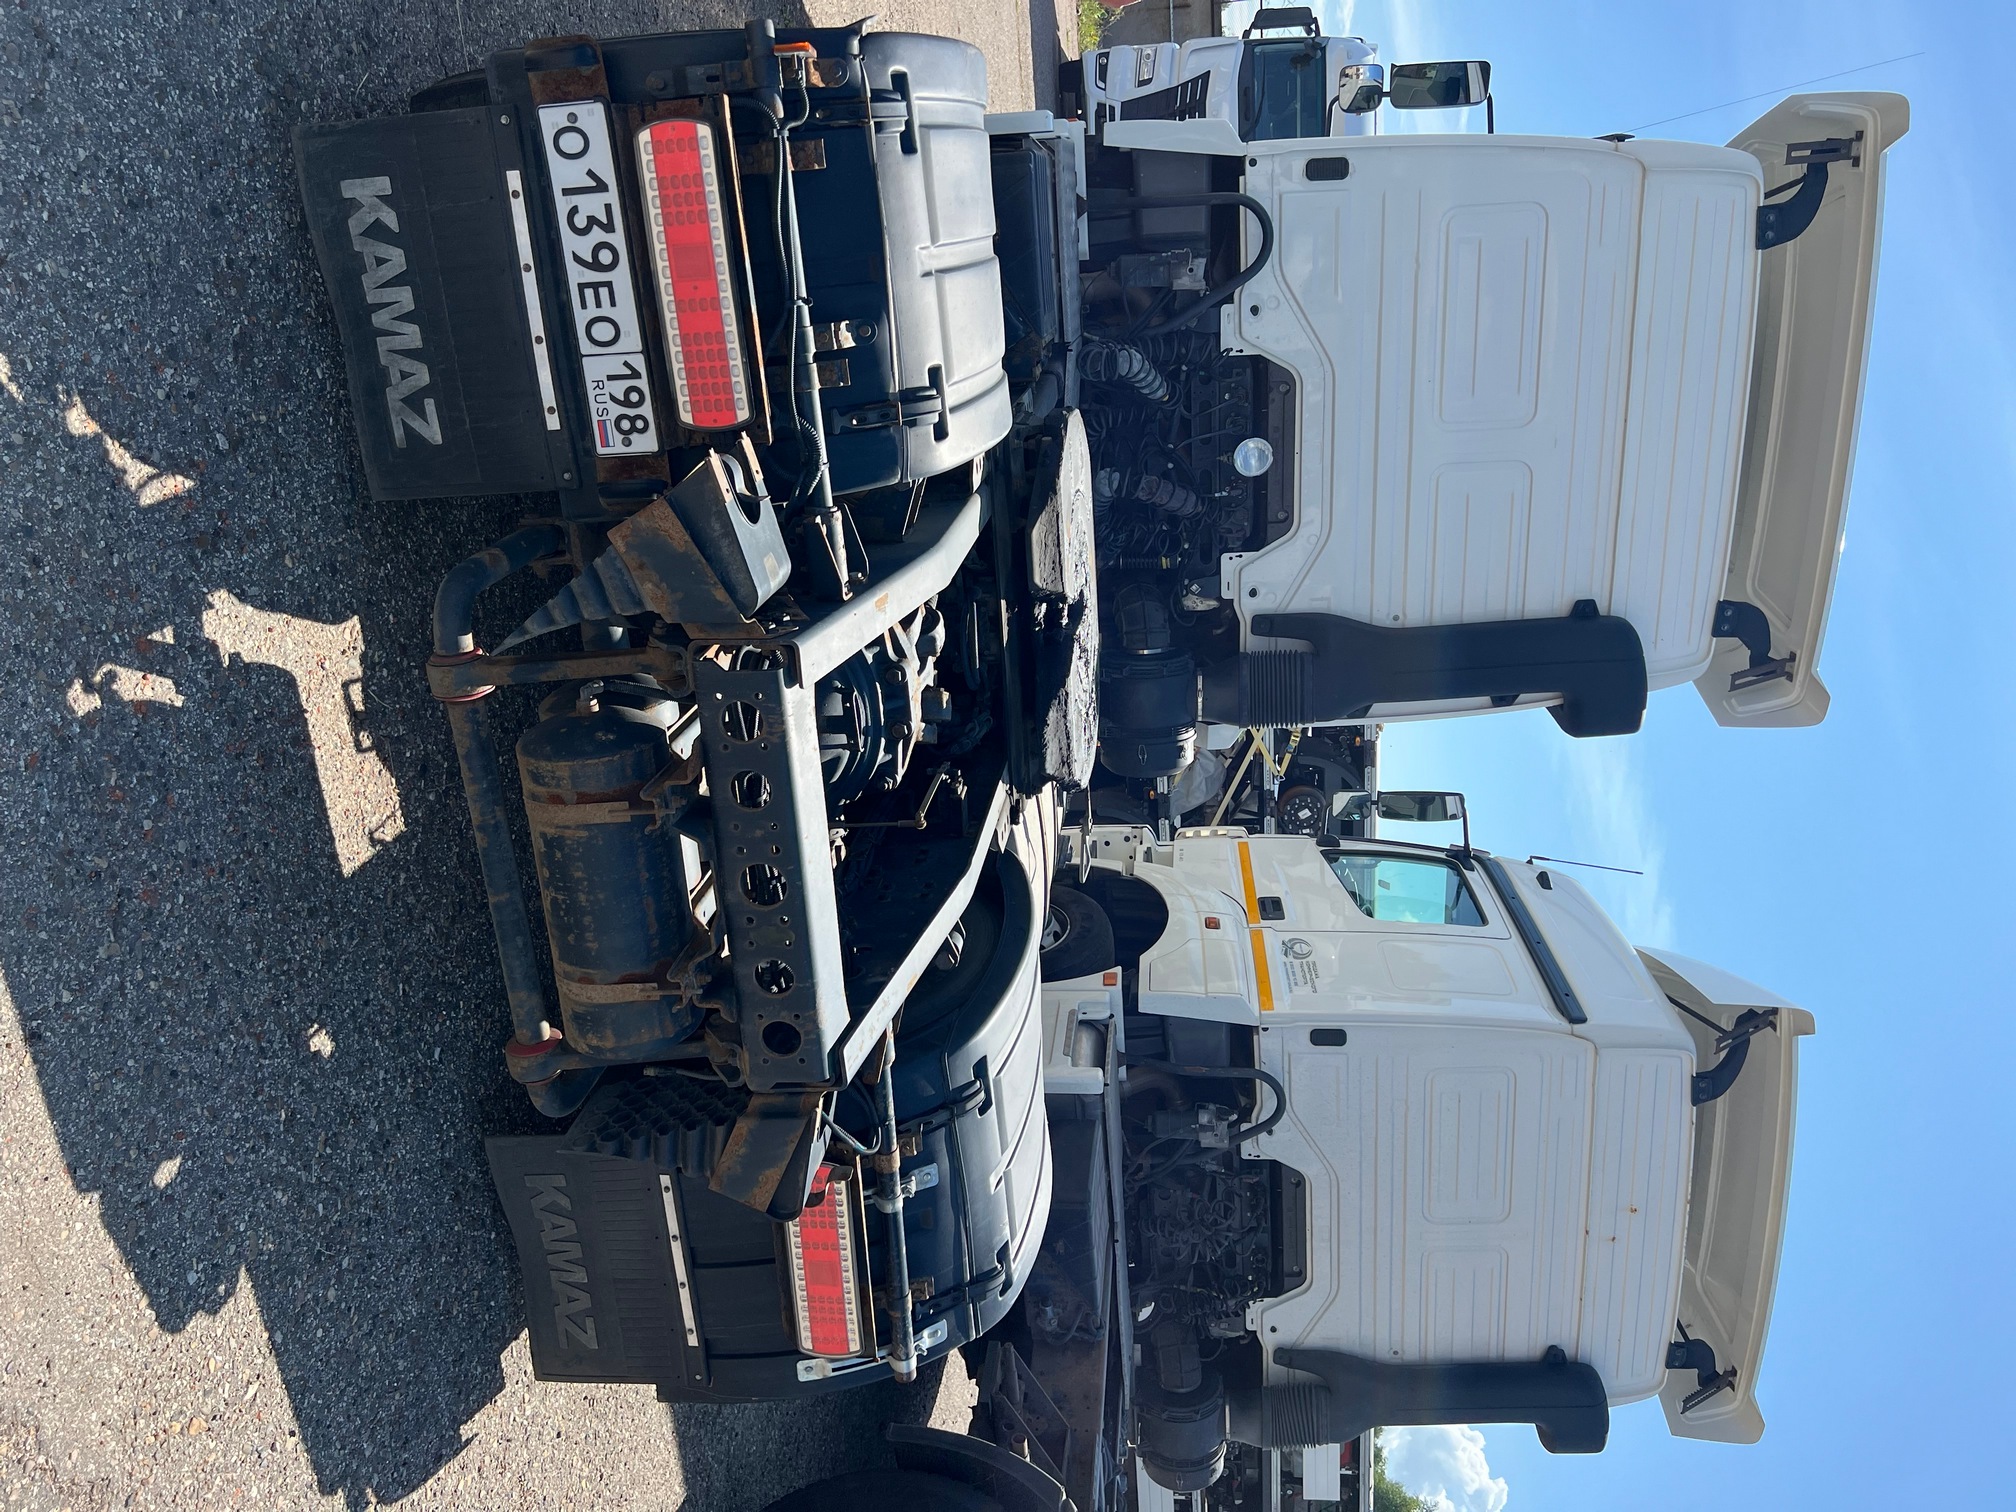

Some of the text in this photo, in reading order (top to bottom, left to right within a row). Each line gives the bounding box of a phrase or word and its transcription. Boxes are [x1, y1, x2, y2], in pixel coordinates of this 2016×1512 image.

[340, 176, 443, 448] KAMAZ
[591, 379, 609, 418] RUS
[605, 359, 649, 435] 198
[524, 1174, 598, 1349] KAMAZ
